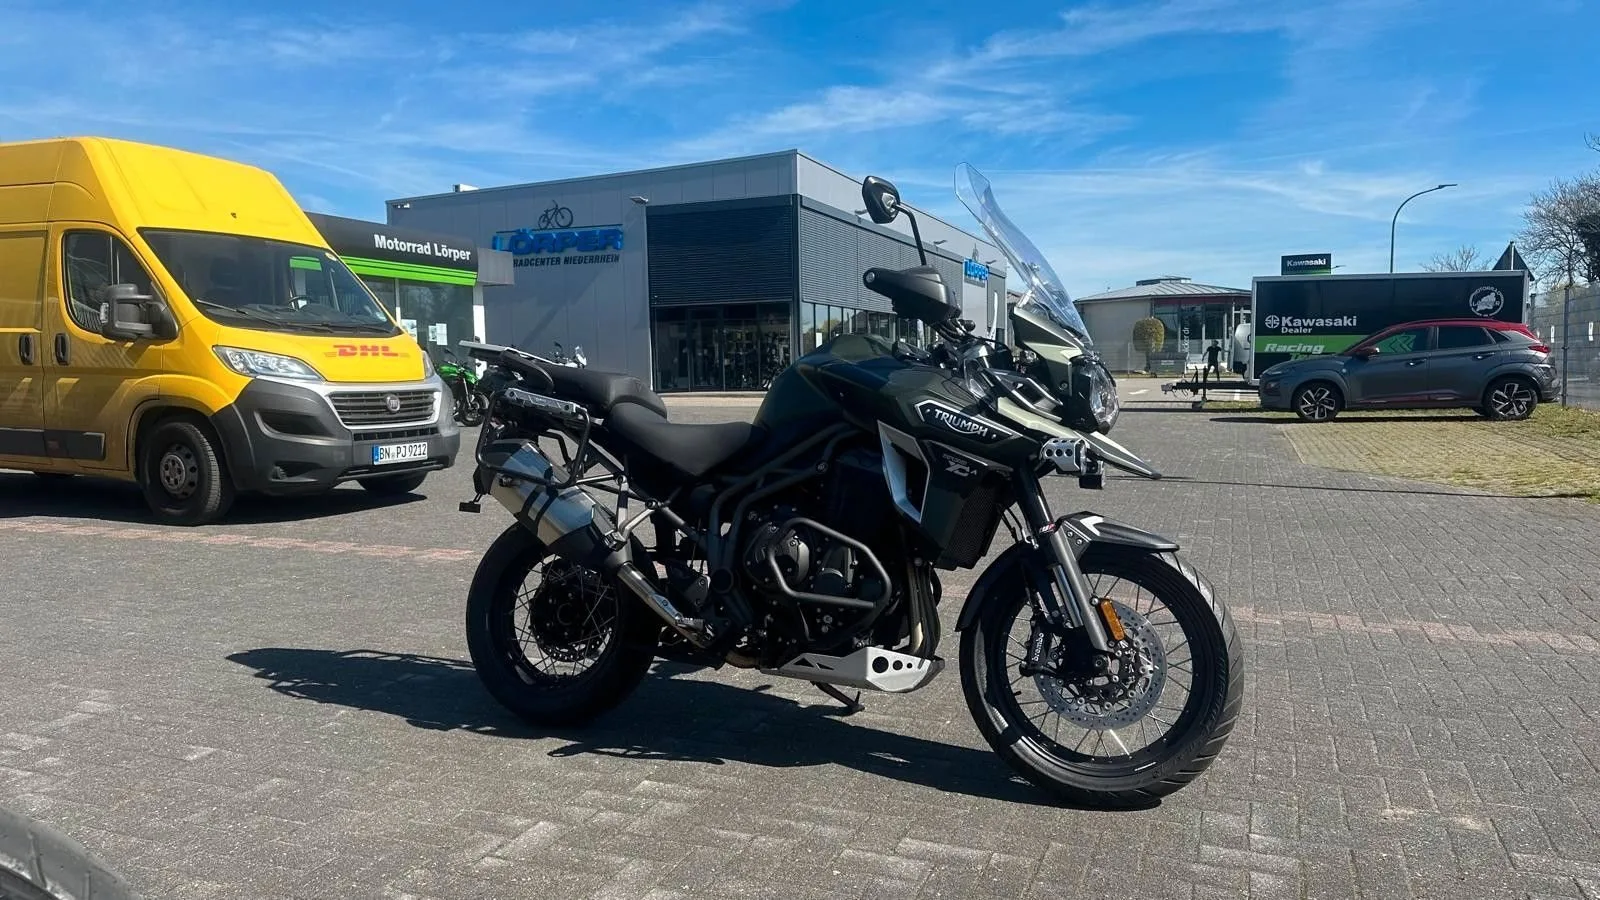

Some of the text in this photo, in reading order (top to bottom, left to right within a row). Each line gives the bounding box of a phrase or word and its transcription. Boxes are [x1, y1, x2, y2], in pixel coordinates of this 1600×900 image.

[373, 233, 471, 262] Motorrad Lörper
[564, 254, 620, 265] NIEDERRHEIN
[1286, 258, 1326, 267] Kawasaki
[1281, 315, 1357, 327] Kawasaki
[1281, 326, 1312, 334] Dealer
[333, 344, 399, 357] DHL
[1264, 343, 1325, 355] Racing
[935, 408, 988, 437] TRIUMPH
[379, 443, 427, 460] BN PJ 9212
